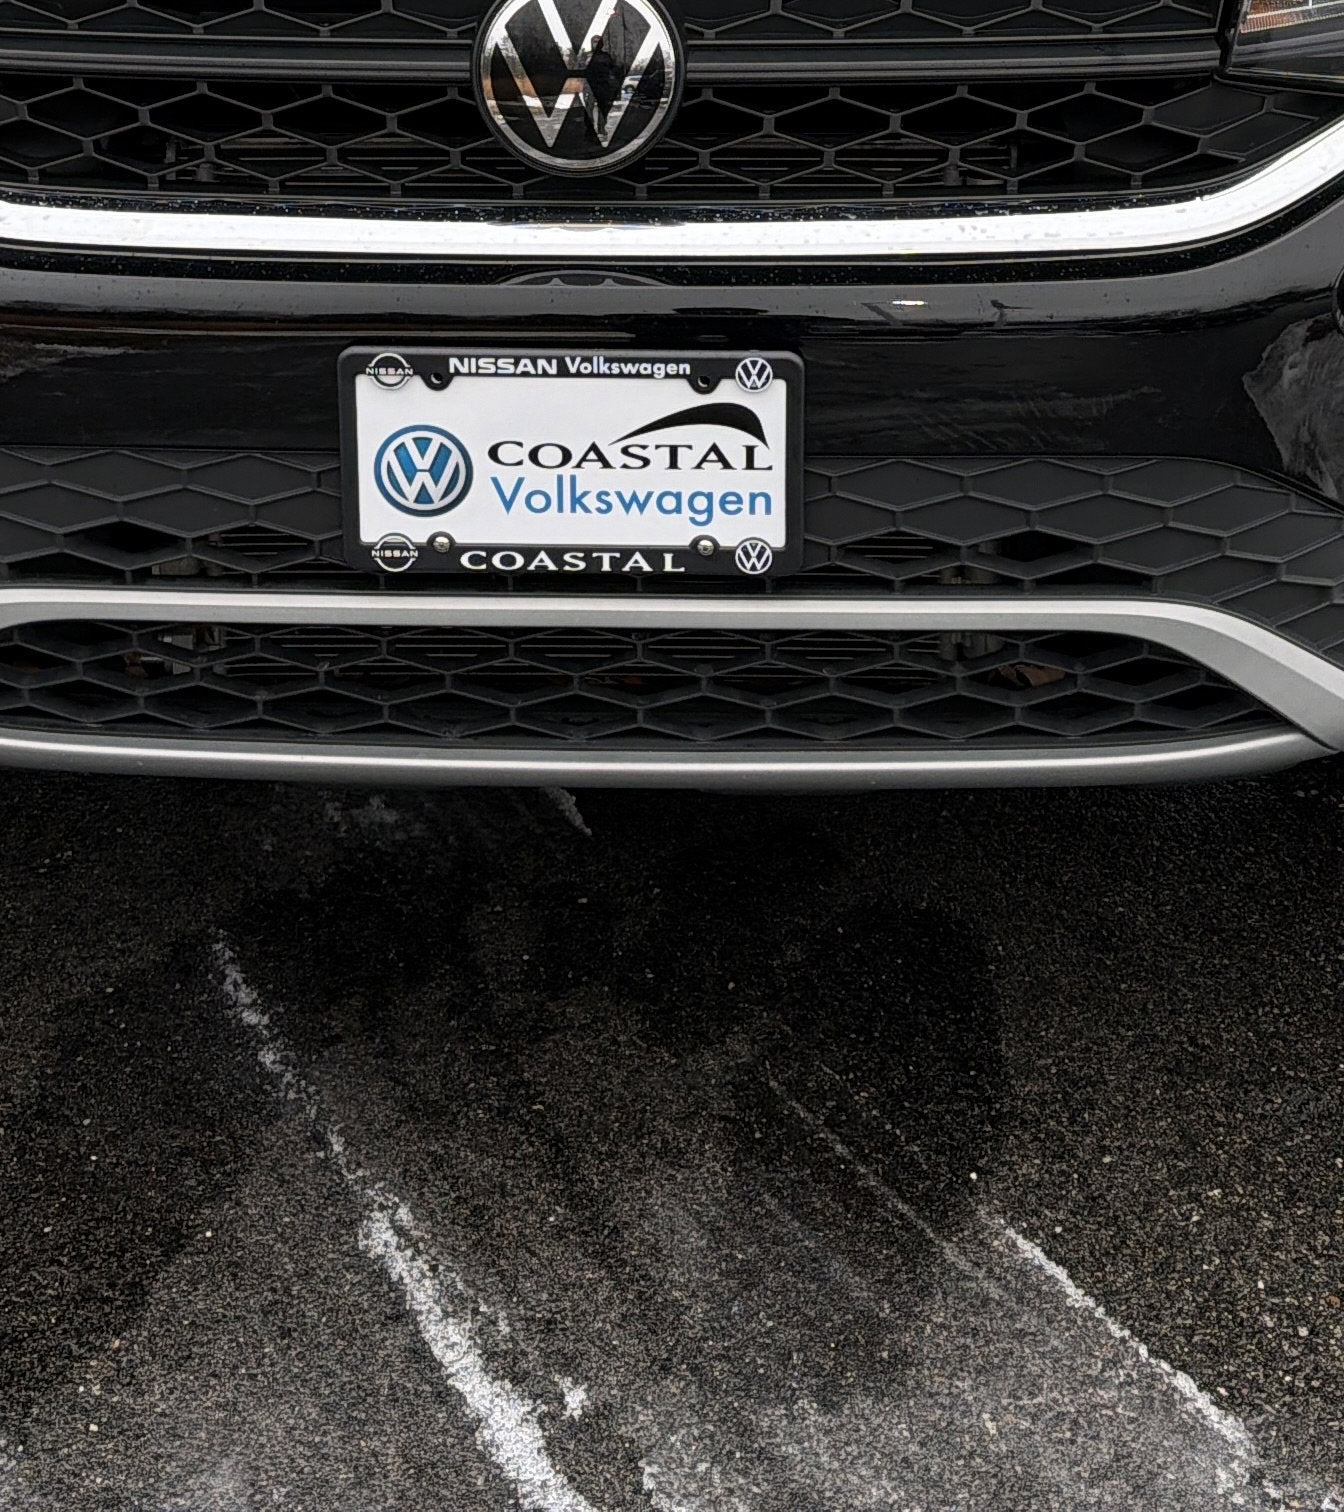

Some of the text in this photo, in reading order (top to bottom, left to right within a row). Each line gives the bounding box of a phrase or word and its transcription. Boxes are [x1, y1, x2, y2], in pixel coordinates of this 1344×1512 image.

[365, 367, 414, 376] NISSAN
[449, 356, 691, 379] NISSAN Volkswagen
[487, 441, 773, 471] COASTAL
[490, 474, 773, 526] Volkswagen
[371, 549, 418, 558] NISSAN
[460, 550, 686, 573] COASTAL
